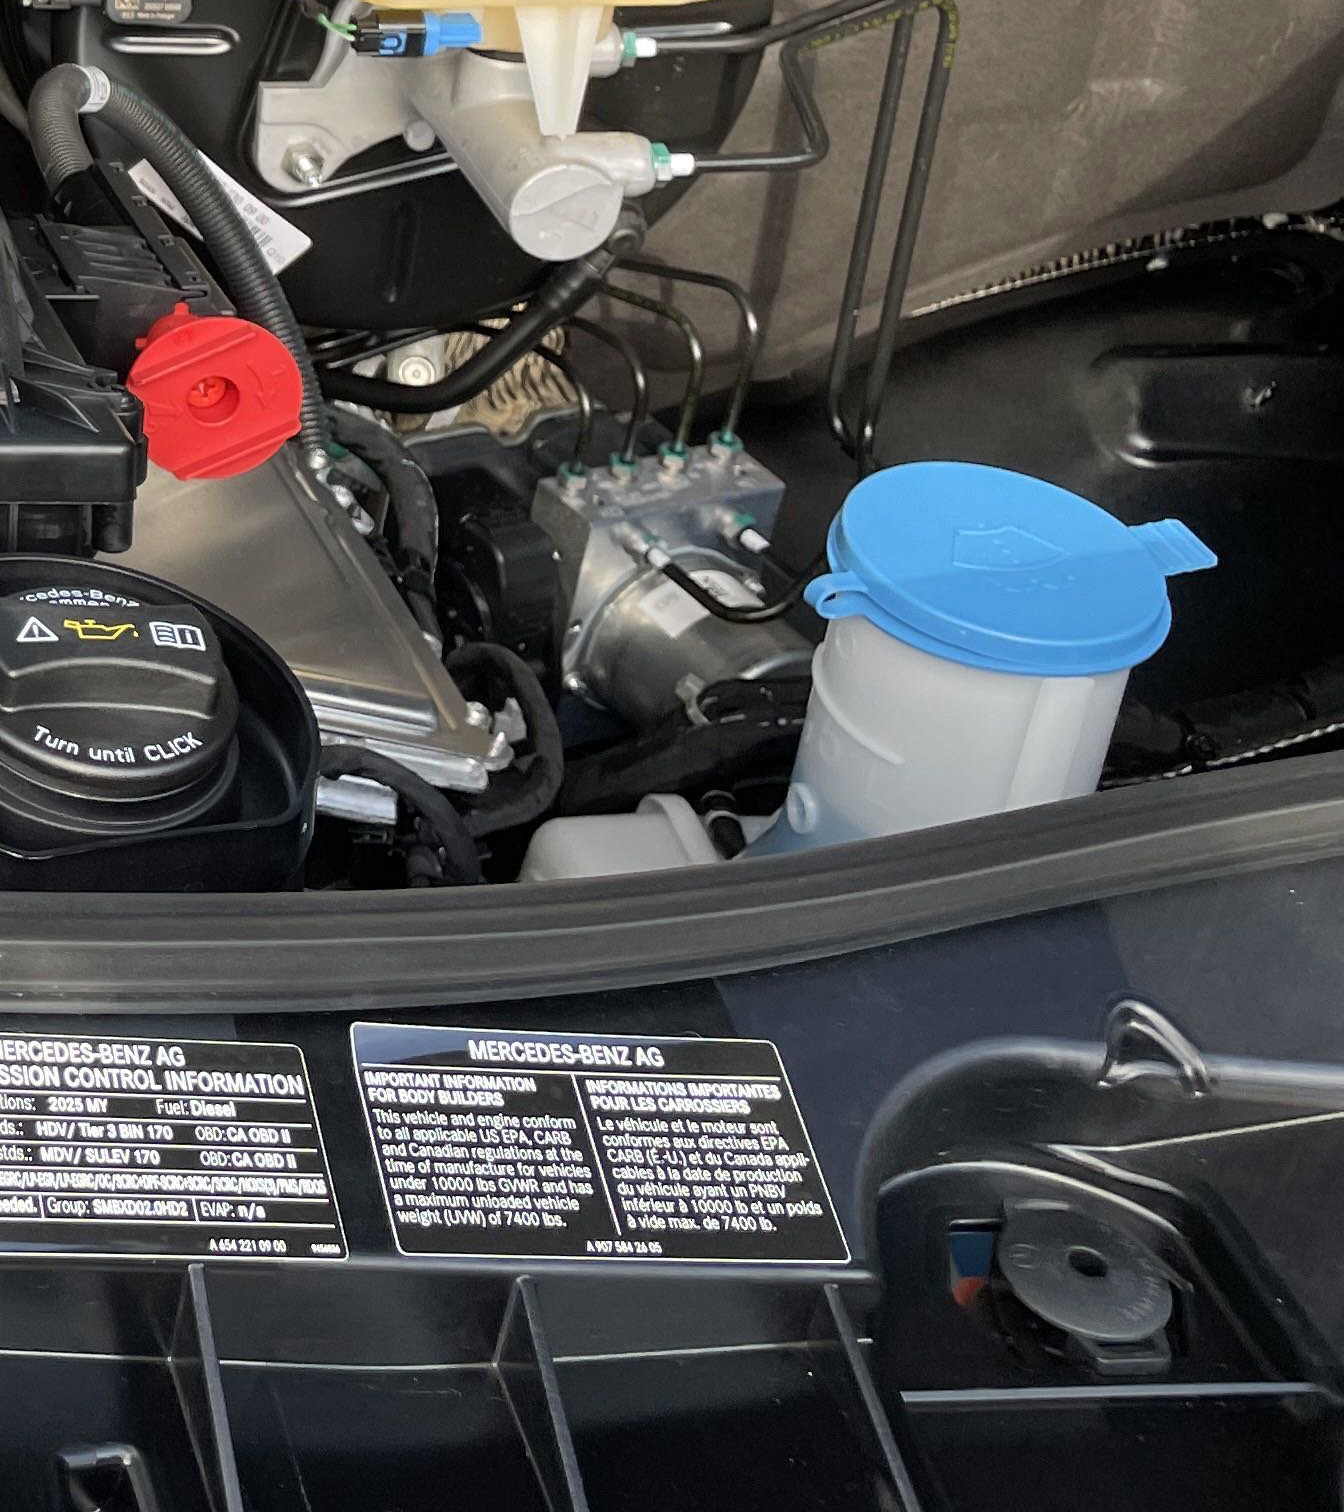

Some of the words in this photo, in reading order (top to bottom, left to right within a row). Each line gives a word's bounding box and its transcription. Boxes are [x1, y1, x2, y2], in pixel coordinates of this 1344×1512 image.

[34, 725, 80, 755] Turn
[88, 746, 136, 763] until
[143, 731, 203, 762] CLICK
[154, 1045, 185, 1067] AG
[467, 1039, 633, 1066] MERCEDES-BENZ
[632, 1045, 665, 1067] AG
[61, 1065, 163, 1091] CONTROL
[163, 1069, 305, 1095] INFORMATION
[362, 1070, 443, 1088] IMPORTANT
[441, 1073, 537, 1092] INFORMATION
[583, 1078, 689, 1097] INFORMATIONS
[685, 1081, 783, 1100] IMPORTANTES
[45, 1096, 86, 1113] 2025
[83, 1097, 110, 1113] MY
[367, 1086, 397, 1103] FOR
[397, 1088, 437, 1104] BODY
[437, 1089, 505, 1107] BUILDERS
[588, 1094, 631, 1111] POUR
[628, 1096, 659, 1112] LES
[654, 1095, 753, 1114] CARROSSIERS
[371, 1108, 402, 1124] This
[400, 1109, 449, 1125] vehicle
[448, 1111, 476, 1126] and
[474, 1112, 522, 1129] engine
[520, 1113, 577, 1130] conform
[77, 1121, 105, 1138] Tier
[118, 1123, 144, 1139] BIN
[146, 1124, 173, 1140] 170
[246, 1127, 280, 1143] OBD
[376, 1125, 393, 1140] to
[393, 1126, 411, 1140] all
[411, 1126, 479, 1144] applicable
[478, 1128, 500, 1143] US
[499, 1128, 533, 1146] EPA,
[531, 1129, 572, 1145] CARB
[84, 1147, 131, 1164] SULEV
[133, 1148, 161, 1165] 170
[252, 1152, 285, 1168] OBD
[380, 1141, 407, 1156] and
[407, 1142, 469, 1158] Canadian
[469, 1144, 544, 1163] regulations
[544, 1146, 559, 1161] at
[559, 1146, 584, 1162] the
[383, 1157, 416, 1173] time
[415, 1158, 432, 1173] of
[432, 1158, 516, 1176] manufacture
[515, 1161, 537, 1176] for
[536, 1162, 592, 1178] vehicles
[387, 1174, 429, 1190] under
[430, 1175, 475, 1191] 10000
[474, 1177, 498, 1192] lbs
[495, 1177, 541, 1193] GVWR
[539, 1179, 569, 1194] and
[566, 1179, 595, 1194] has
[45, 1196, 91, 1216] Group:
[199, 1201, 235, 1217] EVAP:
[236, 1202, 266, 1220] n/a
[392, 1193, 404, 1206] a
[403, 1192, 470, 1208] maximum
[470, 1193, 533, 1209] unloaded
[531, 1194, 581, 1210] vehicle
[394, 1207, 444, 1227] weight
[441, 1208, 488, 1227] (UVW)
[485, 1210, 504, 1225] of
[502, 1210, 542, 1226] 7400
[540, 1211, 568, 1227] lbs.
